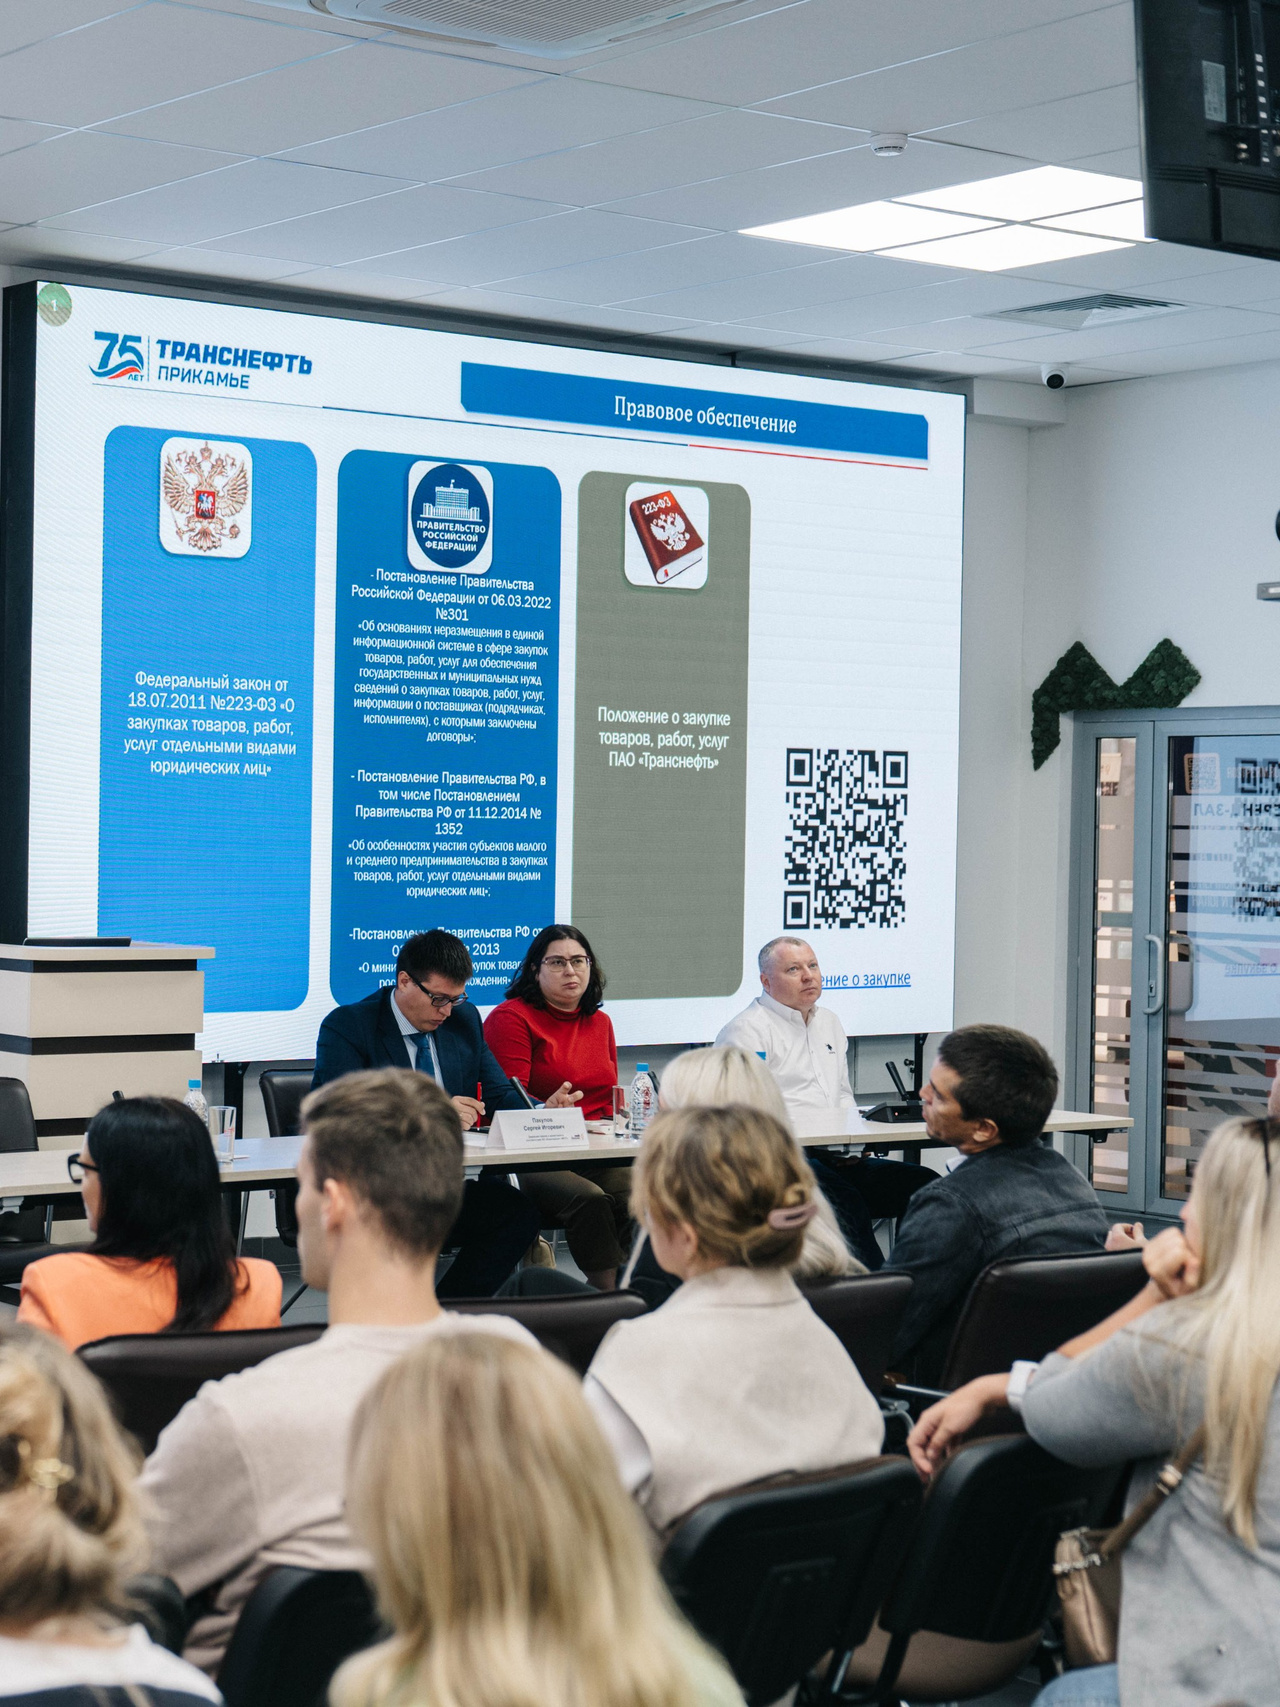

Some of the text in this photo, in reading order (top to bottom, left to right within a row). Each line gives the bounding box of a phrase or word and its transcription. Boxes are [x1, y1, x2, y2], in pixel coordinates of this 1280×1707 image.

[94, 331, 144, 371] 75
[156, 339, 313, 375] ТРАНСНЕФТЬ
[128, 374, 144, 382] ЛЕТ
[158, 366, 250, 389] ПРИКАМЬЕ
[615, 395, 797, 434] Правовое обеспечение
[641, 496, 672, 516] 223-ФЗ
[417, 520, 486, 534] ПРАВИТЕЛЬСТВО
[422, 530, 479, 542] РОССИЙСКОЙ
[425, 540, 477, 552] ФЕДЕРАЦИИ
[376, 568, 535, 591] Постановление Правительства
[351, 585, 552, 609] Российской Федерации от 06.03.2022
[435, 608, 469, 622] №301
[357, 620, 544, 641] «Об основаниях неразмещения единой
[353, 635, 548, 657] информационной системе сфере закупок
[364, 653, 537, 671] товаров, работ, услуг для обеспечения
[135, 671, 288, 691] Федеральный закон от
[359, 668, 542, 687] государственных муниципальных нужд
[354, 682, 545, 702] сведений закупках товаров, работ, услуг,
[128, 692, 295, 712] 18.07.2011 №223-ФЗ «О
[353, 698, 546, 716] информации поставщиках (подрядчиках,
[363, 714, 537, 730] исполнителях), которыми заключены
[598, 706, 731, 728] Положение о закупке
[127, 717, 293, 736] закупках товаров, работ,
[124, 738, 297, 756] услуг отдельными видами
[599, 731, 729, 750] товаров, работ, услуг
[150, 760, 271, 777] юридических лиц»
[609, 751, 719, 771] ПАО «Транснефть»
[357, 770, 537, 786] Постановление Правительства РФ,
[379, 789, 520, 802] том числе Постановлением
[355, 805, 542, 820] Правительства РФ от 11.12.2014 №
[435, 823, 463, 835] 1352
[348, 839, 547, 853] «Об особенностях участия субъектов малого
[355, 856, 548, 868] среднего предпринимательства закупках
[353, 870, 540, 883] товаров, работ, услуг отдельными видами
[406, 886, 467, 898] юридических
[438, 927, 511, 940] авительства
[515, 926, 530, 938] РФ
[472, 943, 500, 956] 2013
[852, 974, 860, 986] о
[863, 972, 911, 988] закупке
